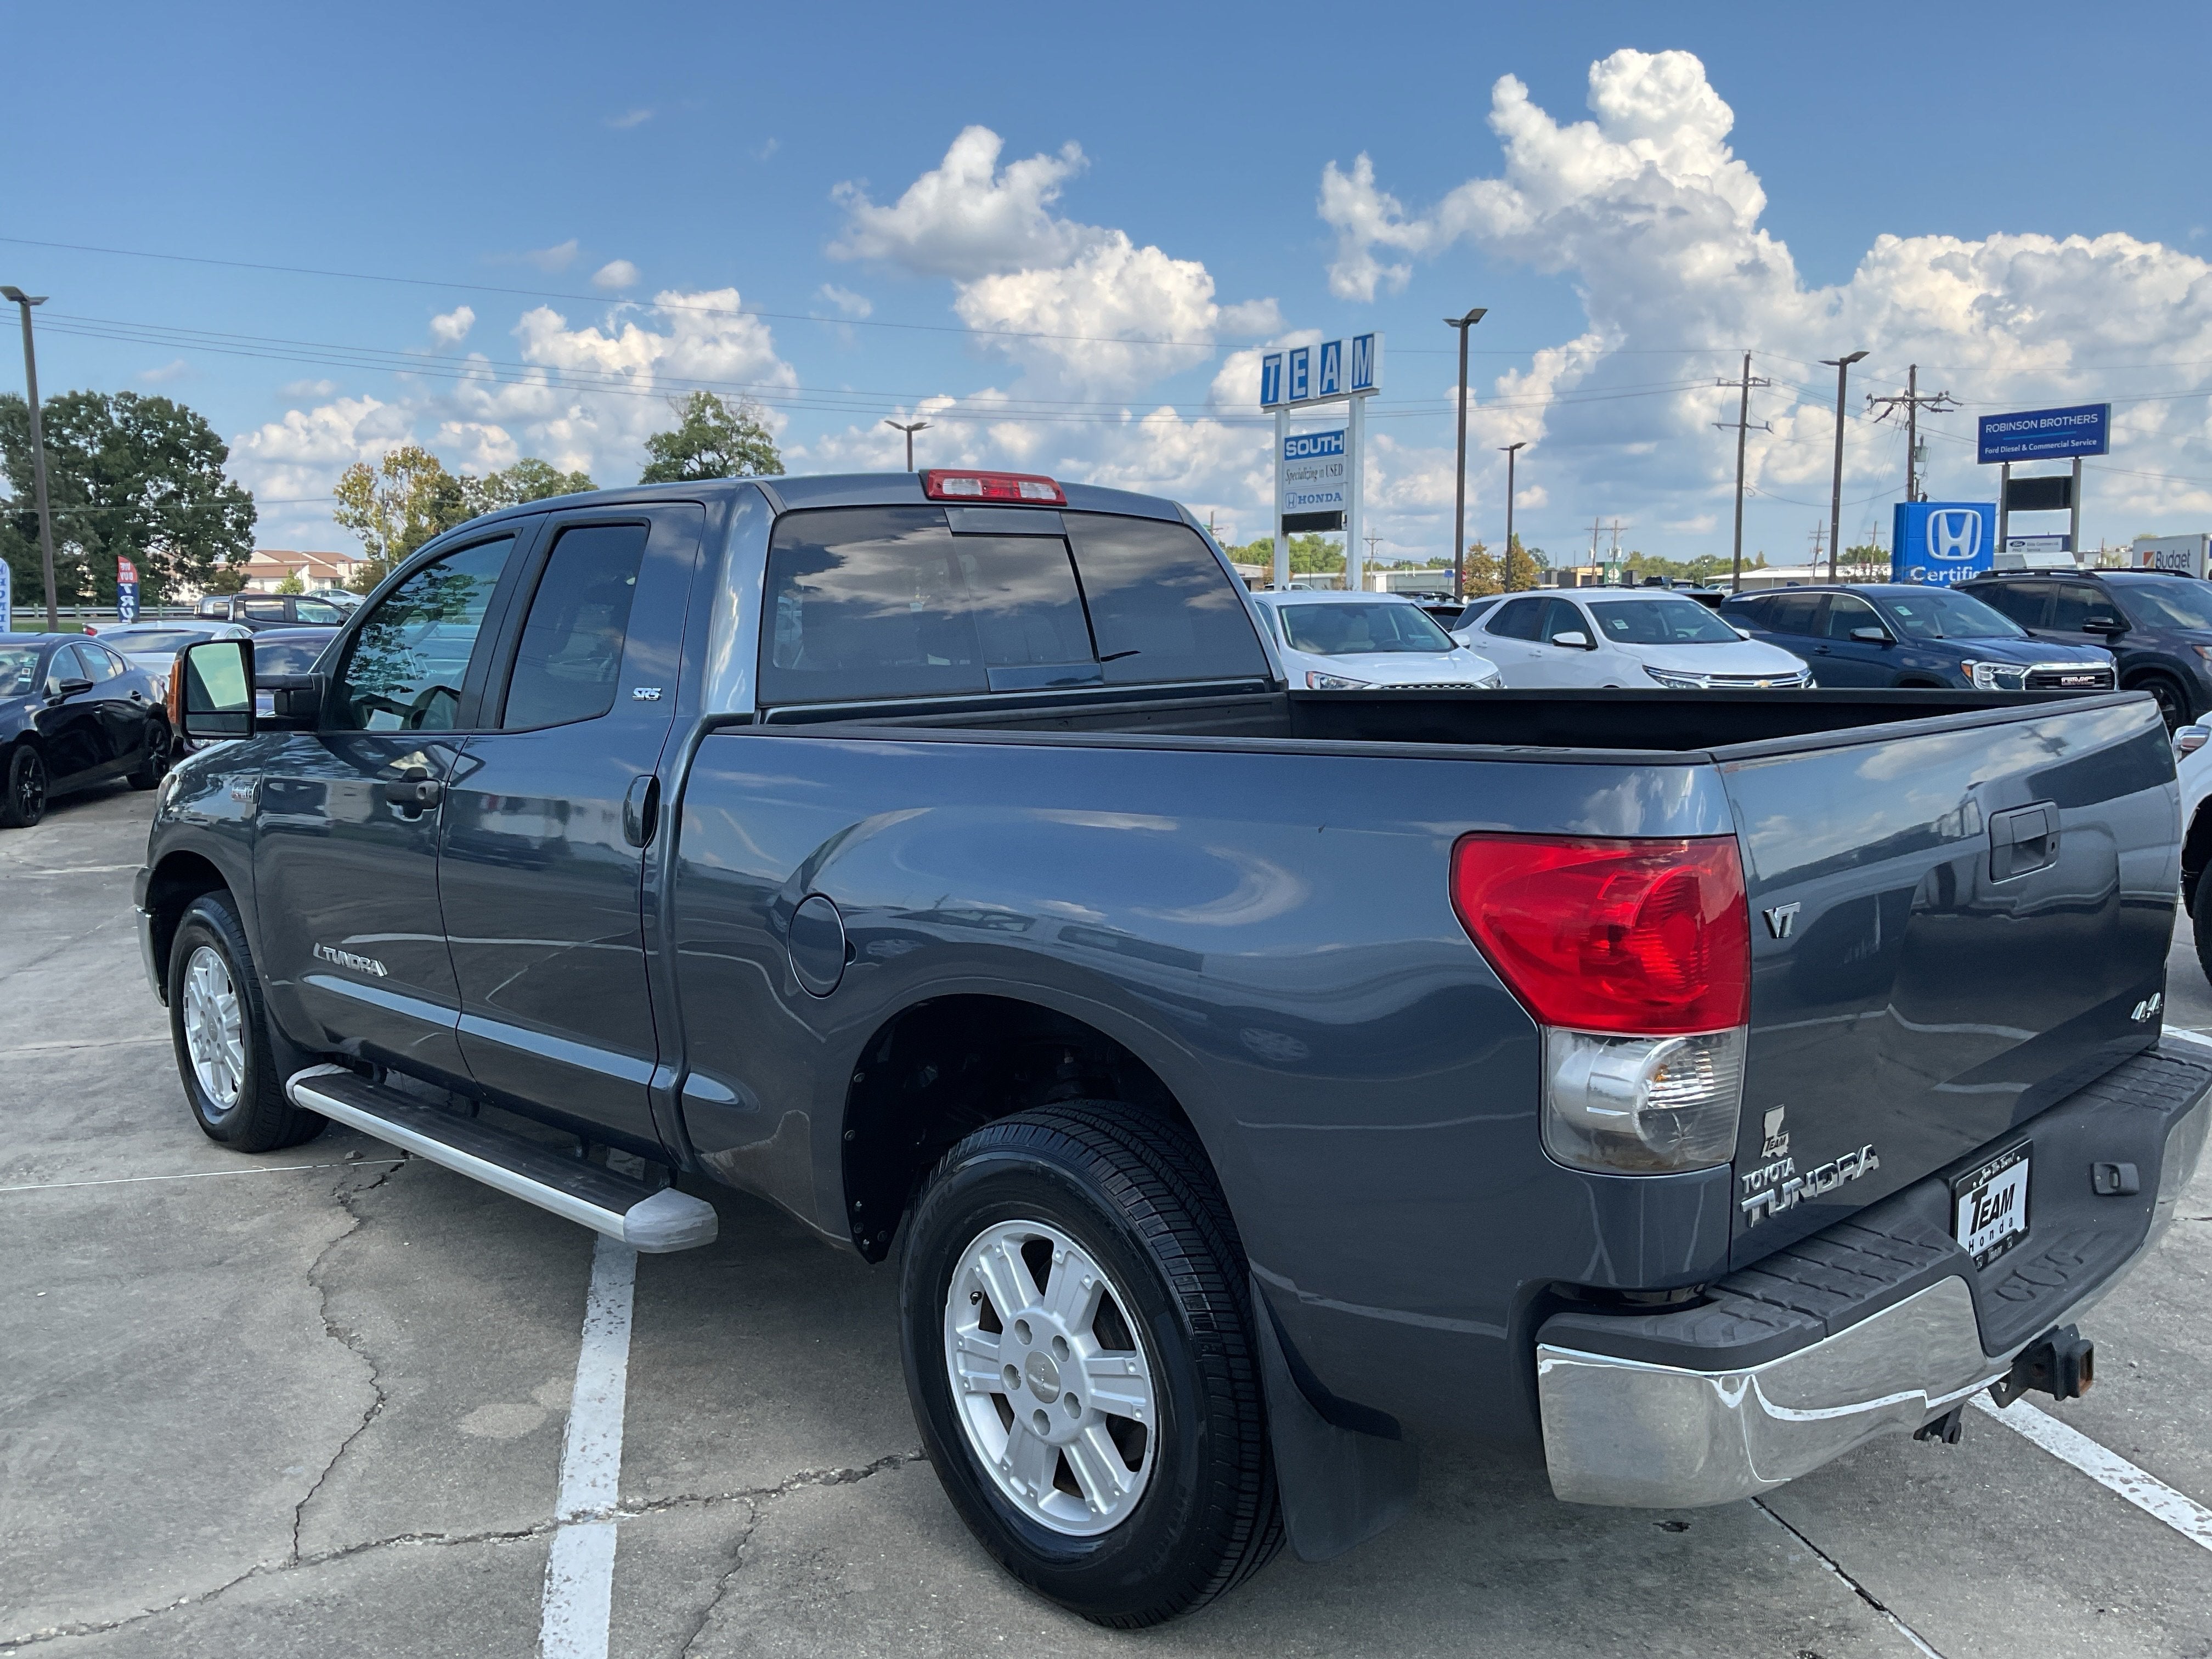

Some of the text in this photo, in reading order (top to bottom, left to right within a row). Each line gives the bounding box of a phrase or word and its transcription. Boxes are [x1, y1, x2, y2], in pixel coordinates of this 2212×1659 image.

[1265, 337, 1373, 401] TEAM
[1985, 414, 2098, 433] ROBINSON BROTHERS
[1285, 434, 1343, 457] SOUTH
[1985, 446, 1999, 454] Ford
[2000, 444, 2021, 453] Diesel
[2029, 440, 2069, 450] Commercial
[2070, 438, 2097, 447] Service
[1285, 463, 1343, 484] Specializing in USED
[1297, 492, 1342, 504] HONDA
[2155, 549, 2191, 569] Budget
[1910, 566, 1991, 582] Certifi
[2061, 676, 2095, 686] GMC
[632, 687, 662, 701] SR5
[319, 945, 388, 977] TUNDRA
[1740, 1157, 1795, 1194] TOYOTA
[1740, 1143, 1880, 1228] TUNDRA
